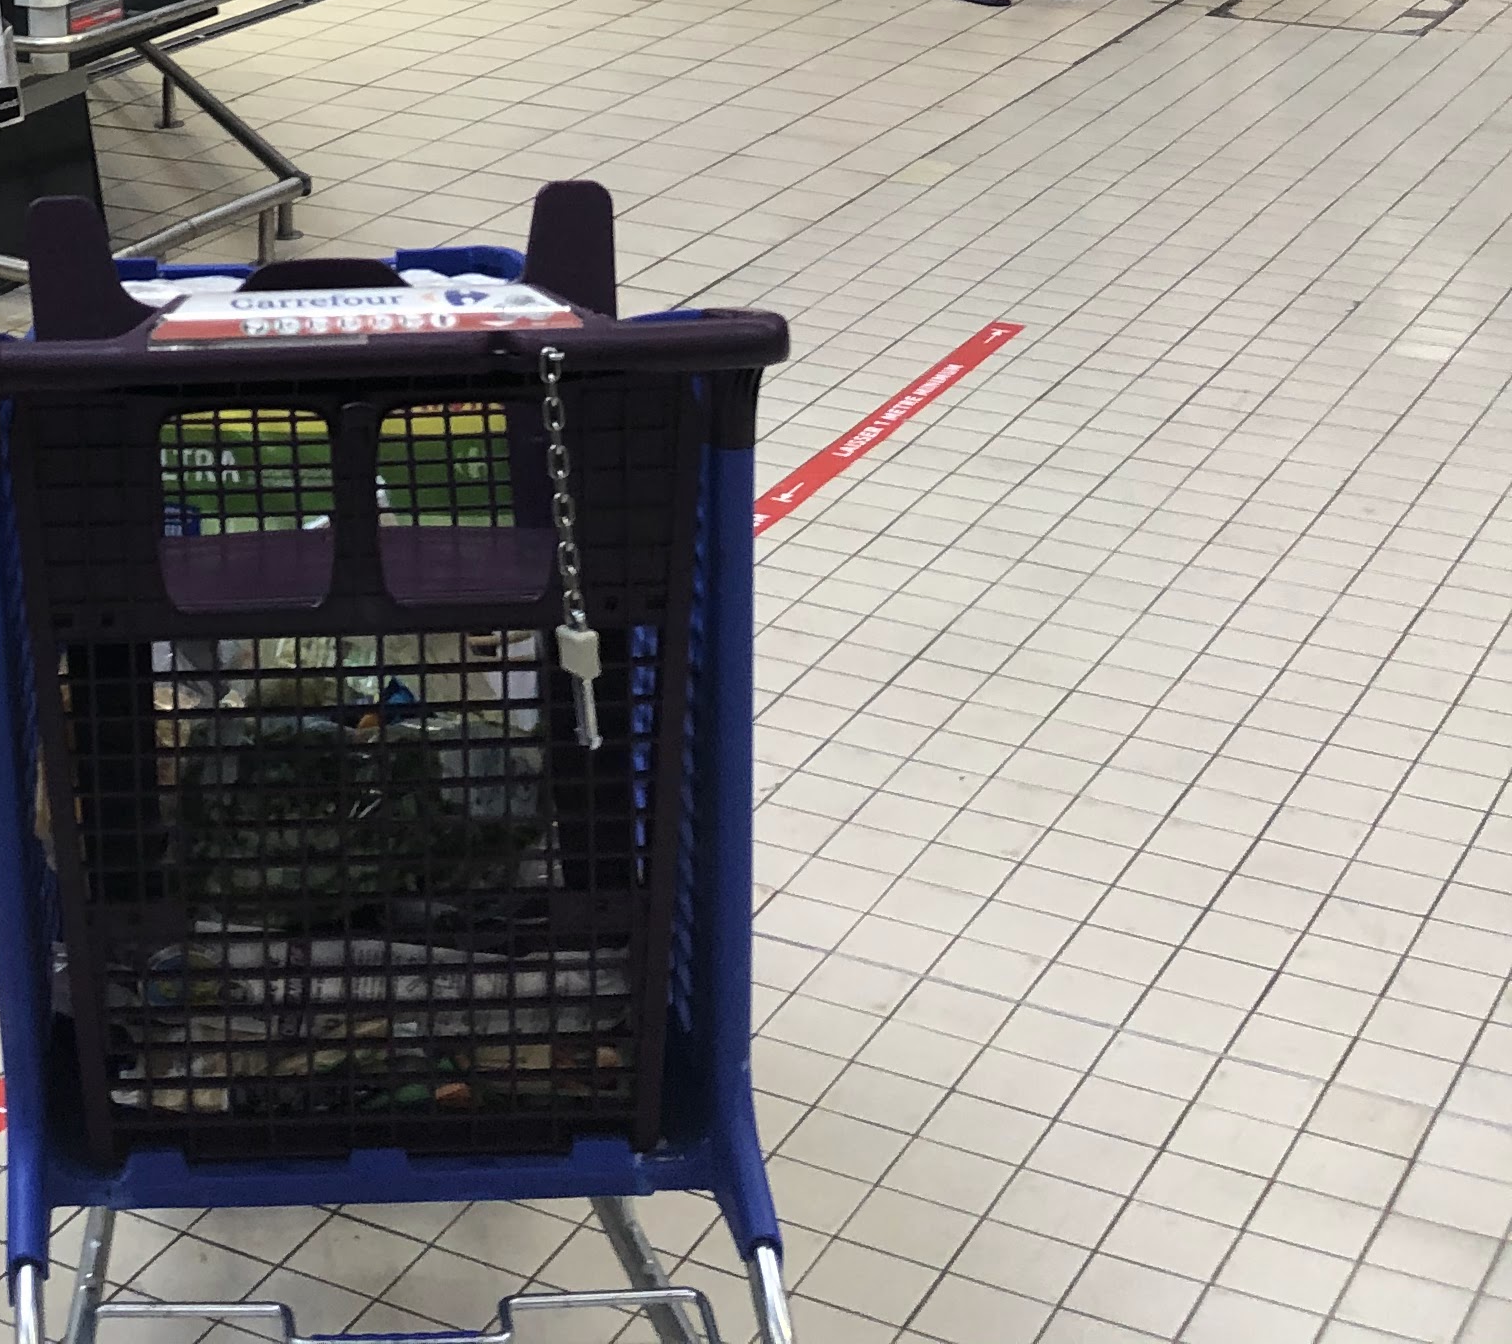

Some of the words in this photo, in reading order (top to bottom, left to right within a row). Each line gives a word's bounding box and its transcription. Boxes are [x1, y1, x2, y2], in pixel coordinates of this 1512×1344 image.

[230, 291, 404, 310] Carrefour
[832, 425, 884, 458] LAISSER
[919, 363, 965, 397] MINIMUM
